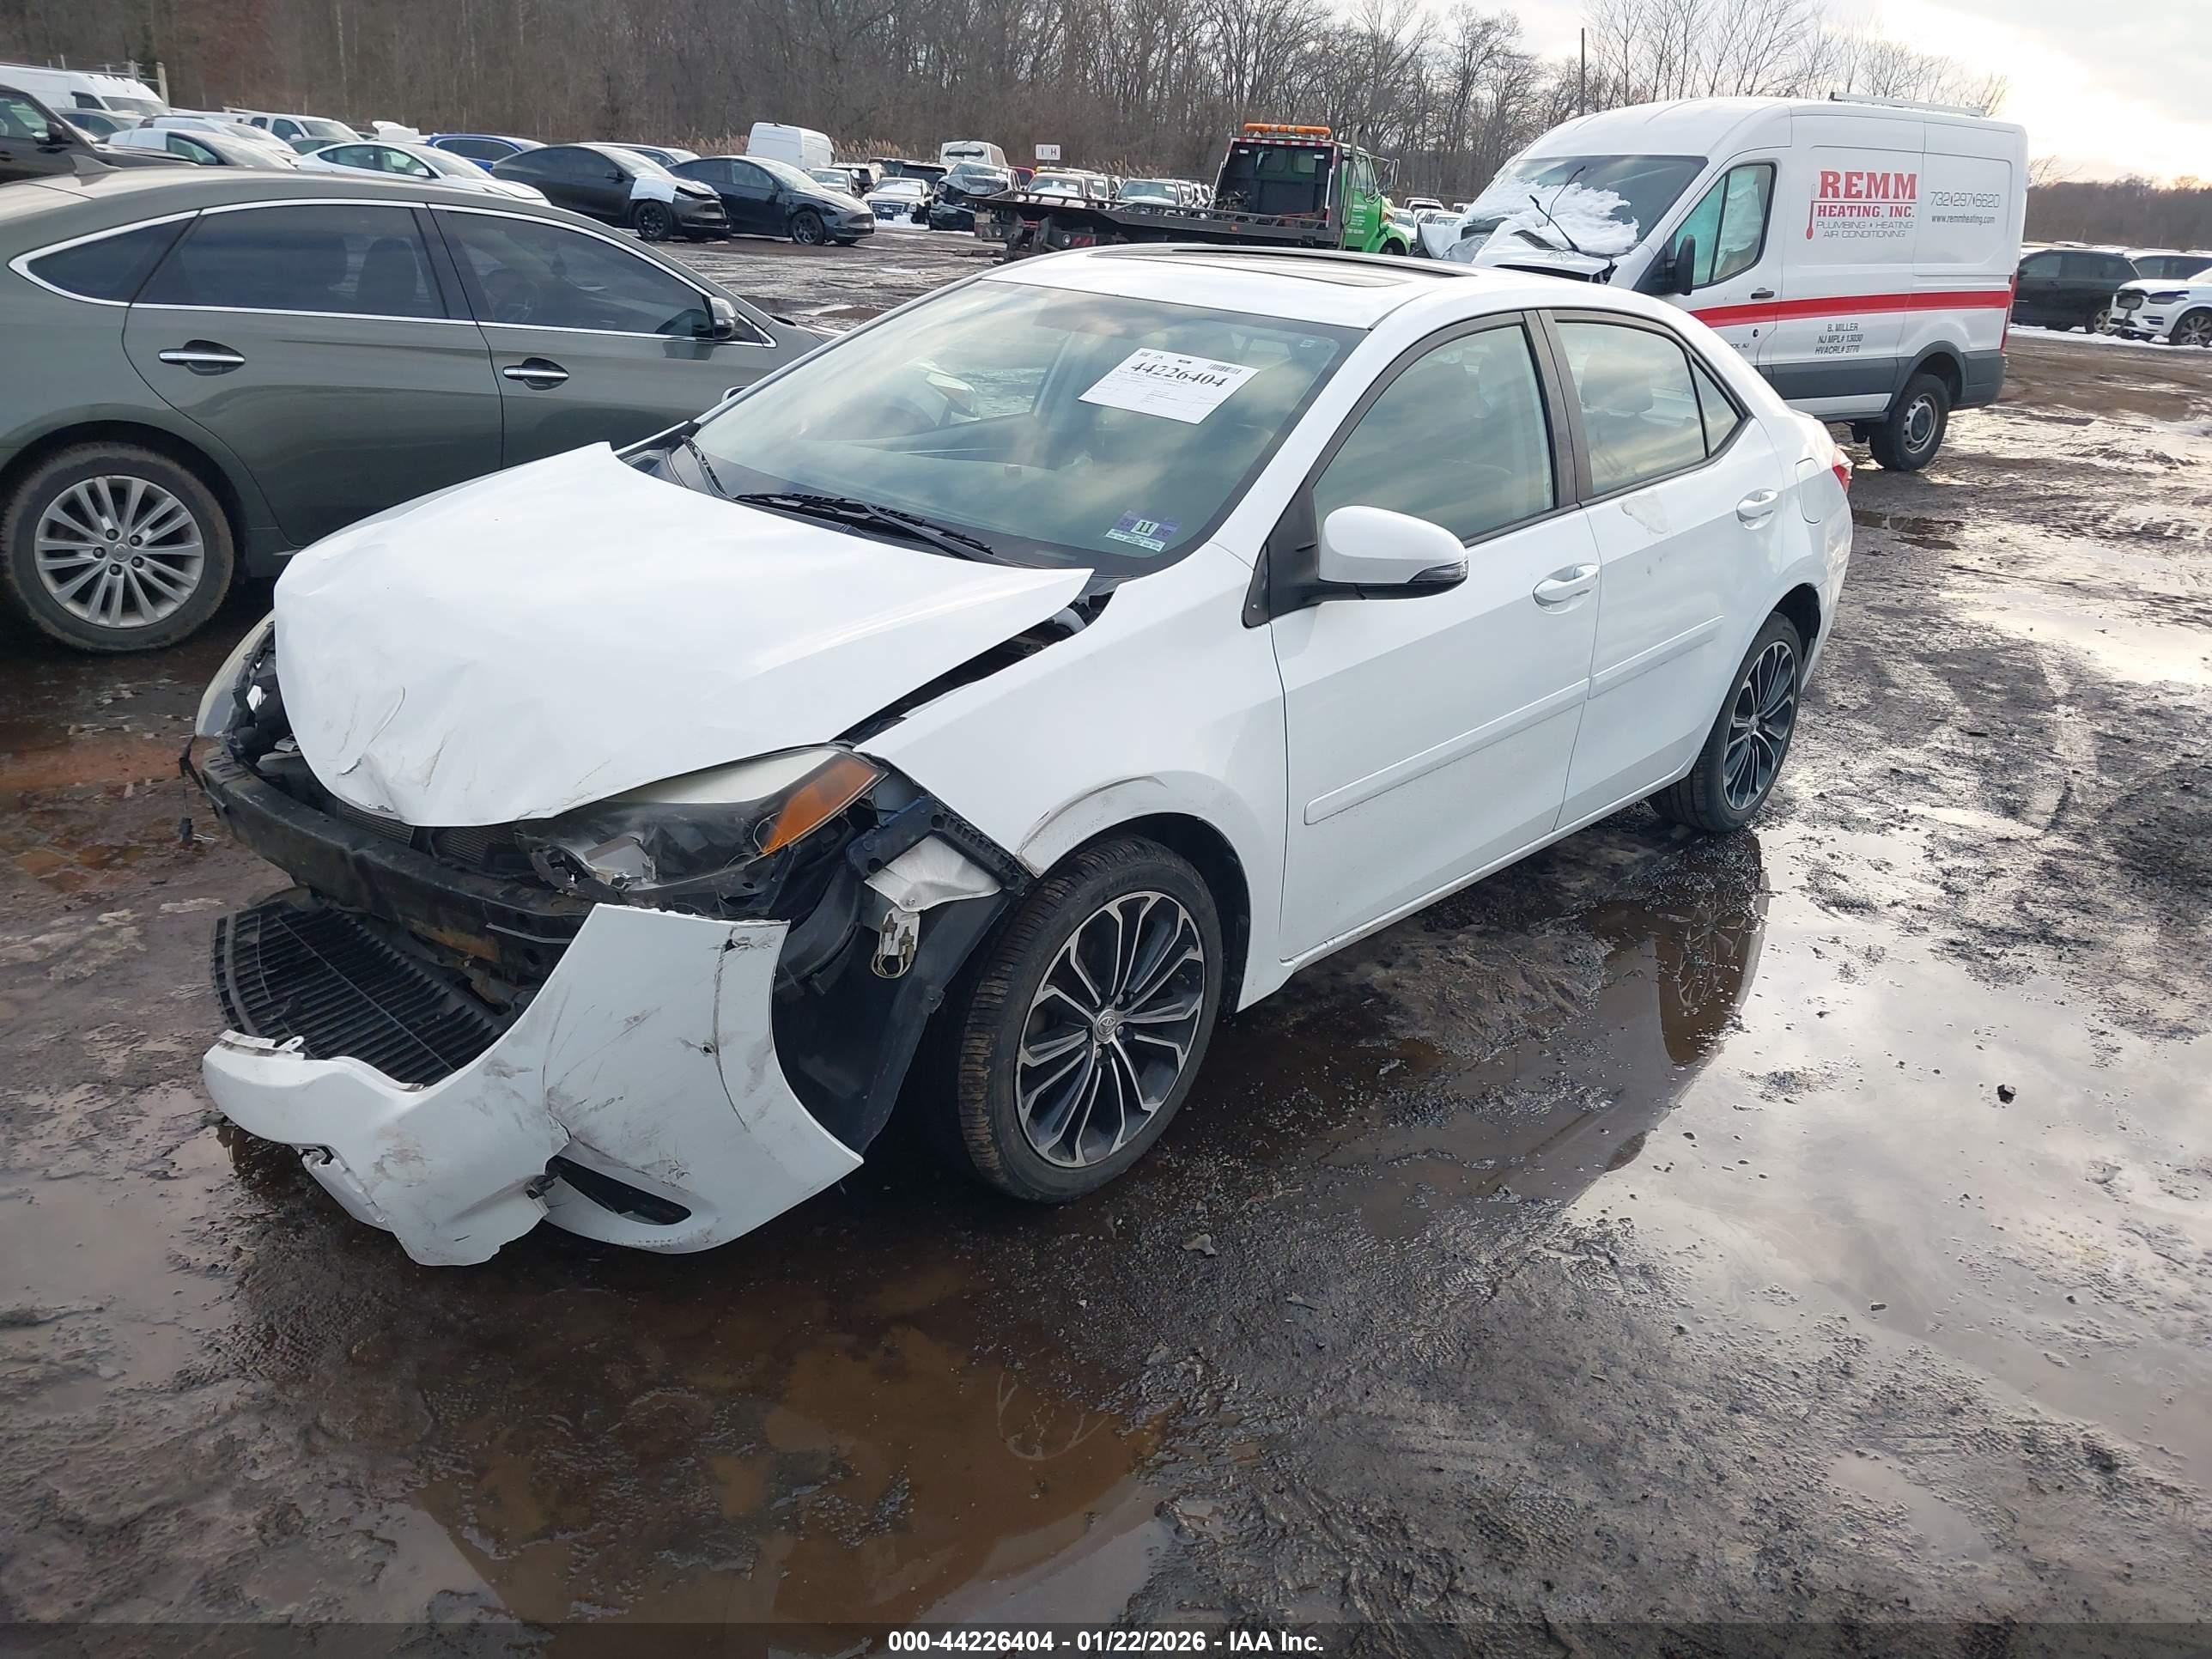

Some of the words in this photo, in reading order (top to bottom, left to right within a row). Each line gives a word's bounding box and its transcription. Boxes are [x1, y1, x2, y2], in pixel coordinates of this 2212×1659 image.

[1819, 171, 1917, 199] REMM
[1888, 205, 1916, 218] INC.
[1816, 220, 1866, 229] PLUMBING
[1875, 221, 1914, 229] HEATING
[1931, 214, 1996, 226] www.remmheating.com
[1841, 230, 1905, 239] CONDITIONING
[1834, 323, 1858, 331] MILLER
[1817, 335, 1827, 344] NJ
[1130, 362, 1229, 387] 44226404
[1136, 521, 1153, 533] 11
